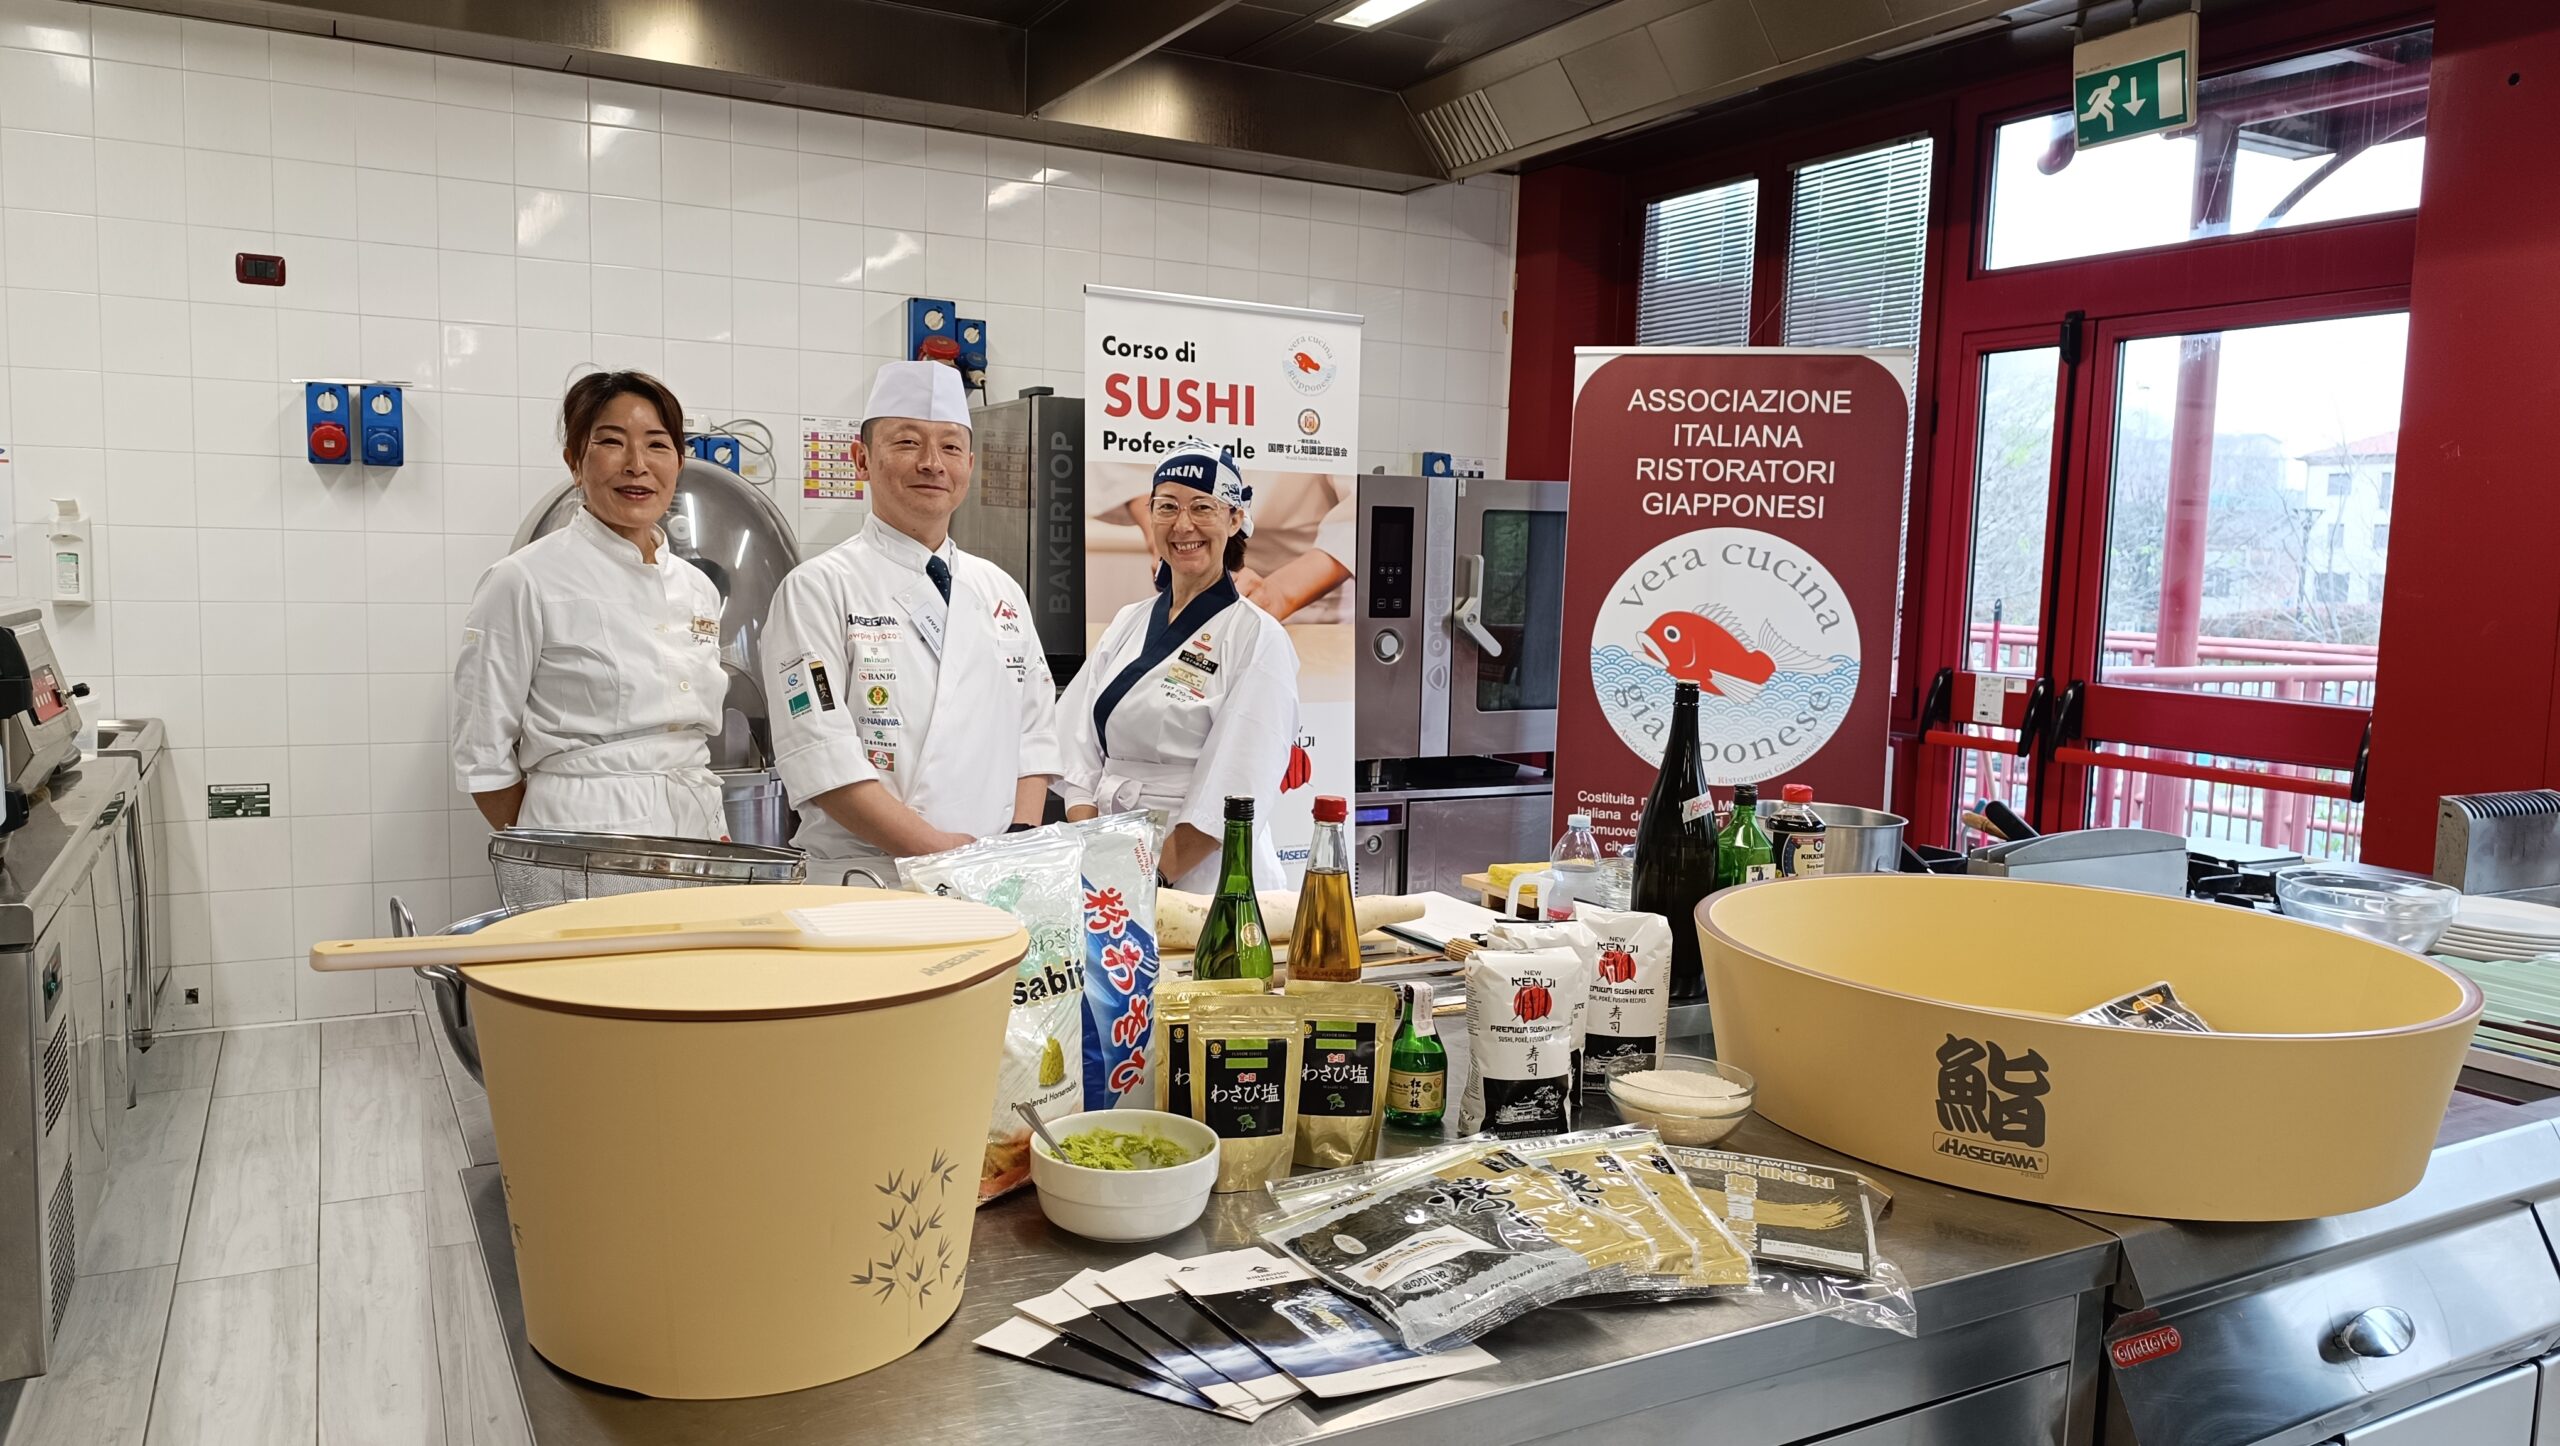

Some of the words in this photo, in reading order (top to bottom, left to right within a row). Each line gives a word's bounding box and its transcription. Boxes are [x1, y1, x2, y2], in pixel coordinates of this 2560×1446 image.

[1102, 335, 1168, 361] Corso
[1175, 341, 1196, 363] di
[1104, 373, 1255, 426] SUSHI
[1627, 388, 1852, 414] ASSOCIAZIONE
[1103, 430, 1256, 460] Profesale
[1673, 423, 1803, 449] ITALIANA
[1158, 464, 1204, 480] IRIN
[1636, 457, 1836, 485] RISTORATORI
[1642, 492, 1825, 519] GIAPPONESI
[1048, 431, 1075, 615] BAKERTOP
[1619, 545, 1707, 611] vera
[1720, 542, 1841, 635] cucina
[868, 672, 897, 681] BANJO
[867, 717, 900, 727] NANIWA
[1613, 682, 1832, 765] giaponese
[1717, 769, 1773, 786] Ristoratori
[1773, 734, 1824, 774] Giapponesi
[1577, 790, 1635, 806] Costituita
[1577, 806, 1622, 821] Italiana
[1588, 823, 1637, 838] omuove
[1597, 941, 1639, 954] KENJI
[1608, 935, 1626, 943] NEW
[1084, 887, 1149, 1093] 粉わさび
[1511, 976, 1557, 989] KENJI
[1612, 996, 1629, 1004] FUSION
[1490, 1024, 1528, 1034] PREMIUM
[1609, 1005, 1622, 1034] 寿司
[1301, 1063, 1370, 1084] わさび塩
[1526, 1045, 1539, 1077] 寿司
[1210, 1082, 1281, 1104] わさび塩
[1935, 1032, 2051, 1148] 鮨
[1678, 1149, 1740, 1161] ROASTED
[1744, 1157, 1808, 1172] SEAWEED
[1938, 1138, 2039, 1171] HASEGAWA
[1674, 1154, 1836, 1190] AKISUSHINORI
[1507, 1267, 1534, 1281] Natural
